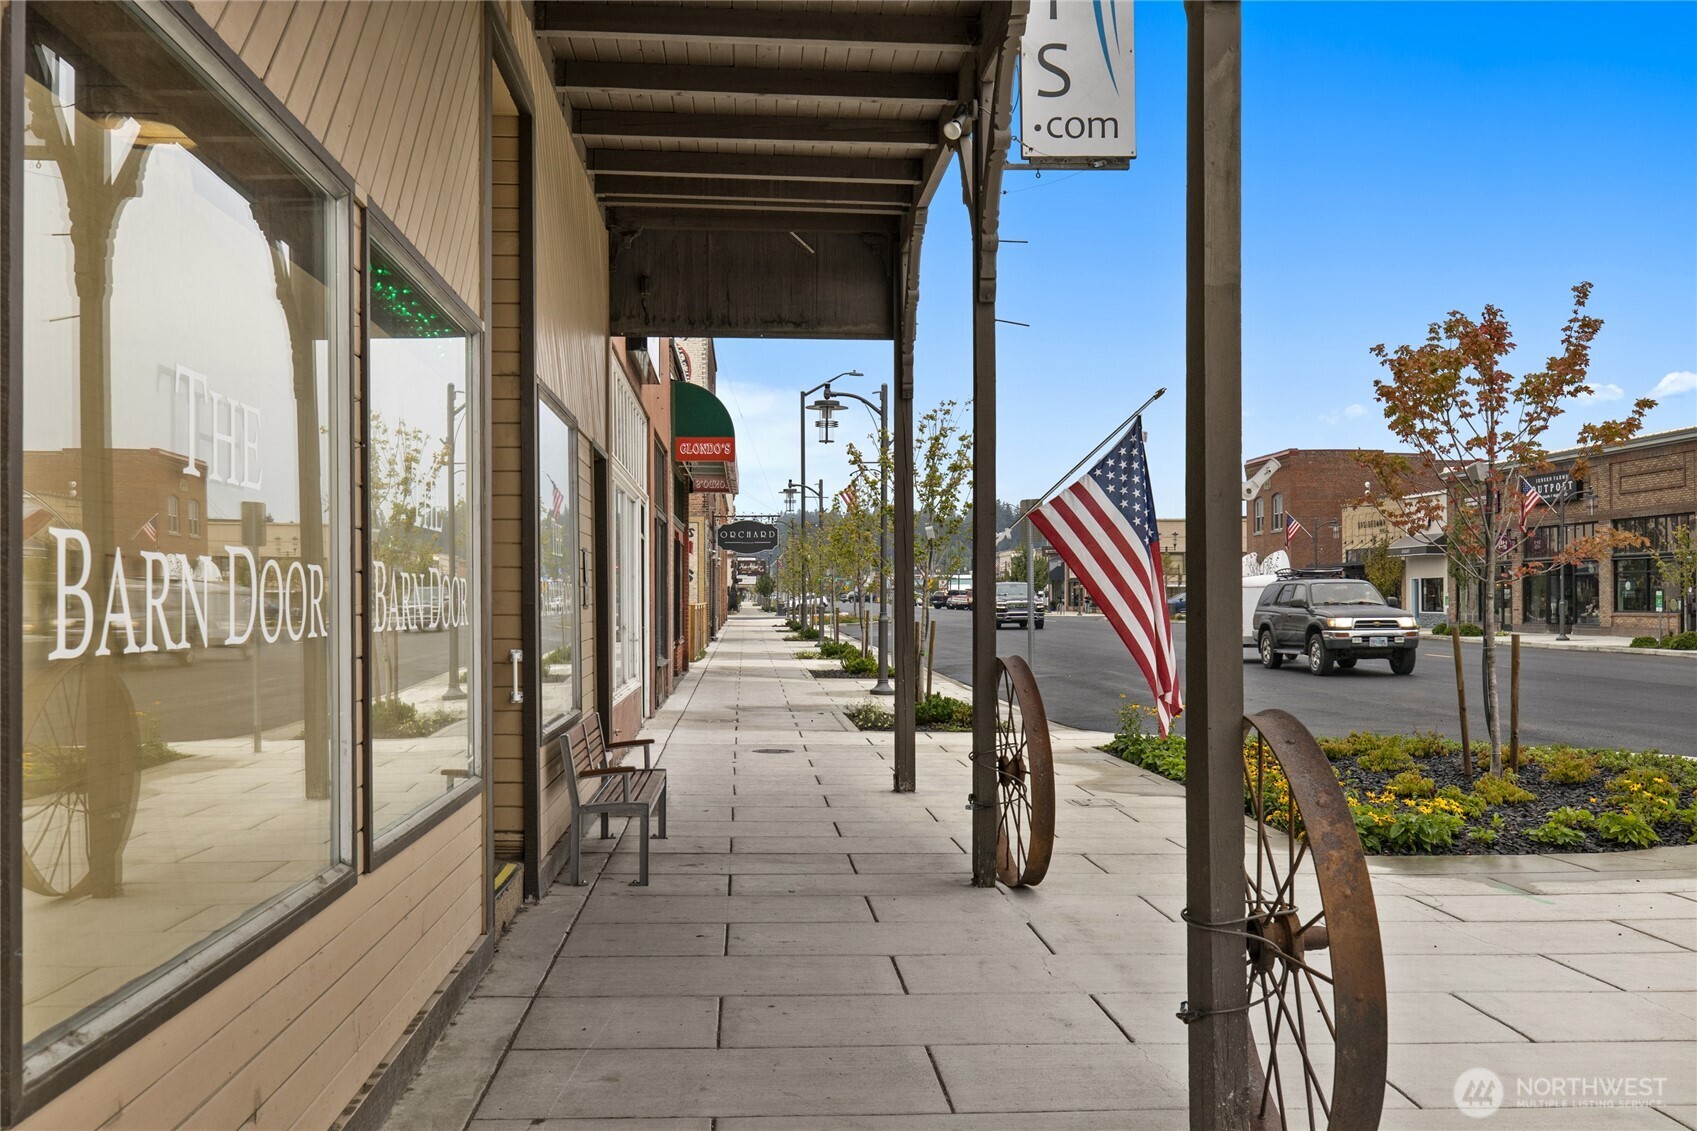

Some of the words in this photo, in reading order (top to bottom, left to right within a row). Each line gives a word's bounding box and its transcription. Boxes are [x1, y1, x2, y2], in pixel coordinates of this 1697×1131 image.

[1034, 116, 1119, 139] .com
[175, 362, 263, 491] THE
[680, 442, 731, 455] GLONDO'S
[720, 530, 776, 539] ORCHARD
[48, 526, 212, 661] BARN
[224, 544, 328, 646] DOOR
[373, 560, 425, 633] BARN
[429, 567, 469, 628] DOOR
